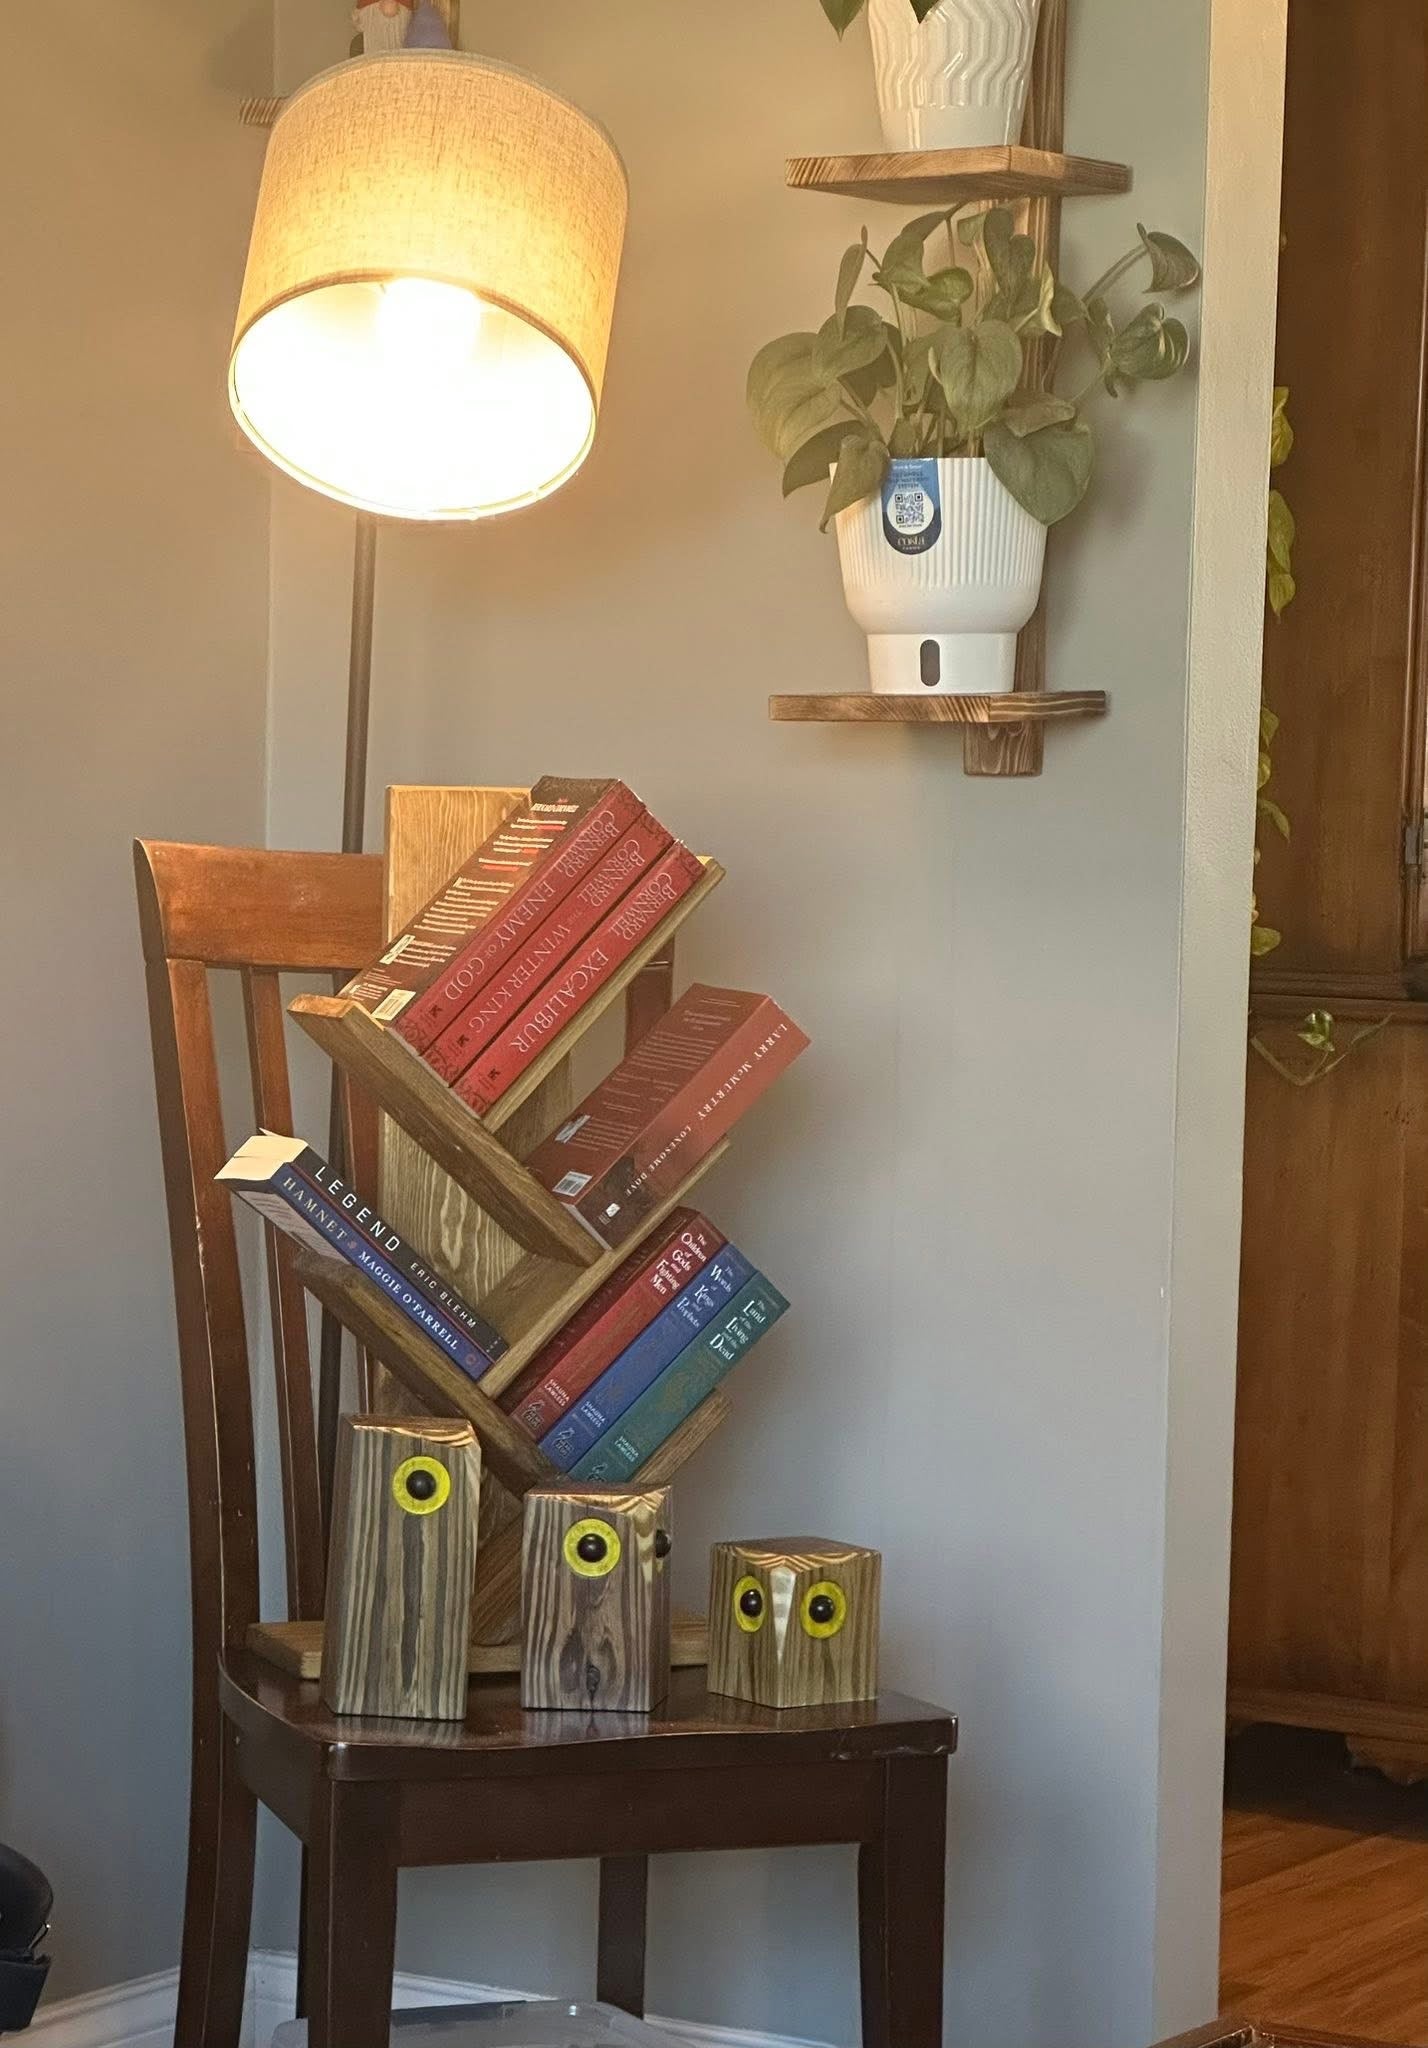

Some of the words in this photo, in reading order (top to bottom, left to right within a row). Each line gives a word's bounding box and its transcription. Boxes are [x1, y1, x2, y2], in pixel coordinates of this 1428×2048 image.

[555, 810, 616, 873] CORNWELL
[565, 822, 620, 878] BERNARD
[577, 839, 640, 902] CORNWELL
[590, 848, 645, 907] BERNARD
[496, 881, 556, 948] ENEMY
[608, 872, 672, 937] CORNWELL
[622, 884, 678, 942] BERNARD
[486, 944, 497, 958] OF
[507, 924, 571, 989] WINTER
[445, 957, 485, 1001] GOD
[509, 948, 609, 1053] EXCALIBUR
[469, 987, 512, 1033] KING
[754, 1023, 788, 1060] LARRY
[649, 1125, 692, 1171] LONESOME
[283, 1177, 347, 1240] HAMNET
[315, 1166, 400, 1251] LEGEND
[672, 1249, 692, 1271] Gods
[681, 1232, 707, 1262] Children
[697, 1234, 707, 1246] The
[410, 1262, 437, 1289] ERIC
[440, 1291, 477, 1328] BLEHM
[651, 1274, 667, 1294] Men
[656, 1259, 680, 1290] Fighting
[358, 1250, 402, 1294] MAGGIE
[402, 1292, 458, 1350] O'FARRELL
[743, 1300, 766, 1323] Land
[709, 1333, 735, 1360] Dead
[725, 1317, 749, 1343] Living
[545, 1384, 566, 1406] LAWLESS
[549, 1379, 570, 1401] SHAUNA
[585, 1401, 606, 1423] SHAUNA
[580, 1405, 602, 1428] LAWLESS
[614, 1440, 635, 1463] LAWLESS
